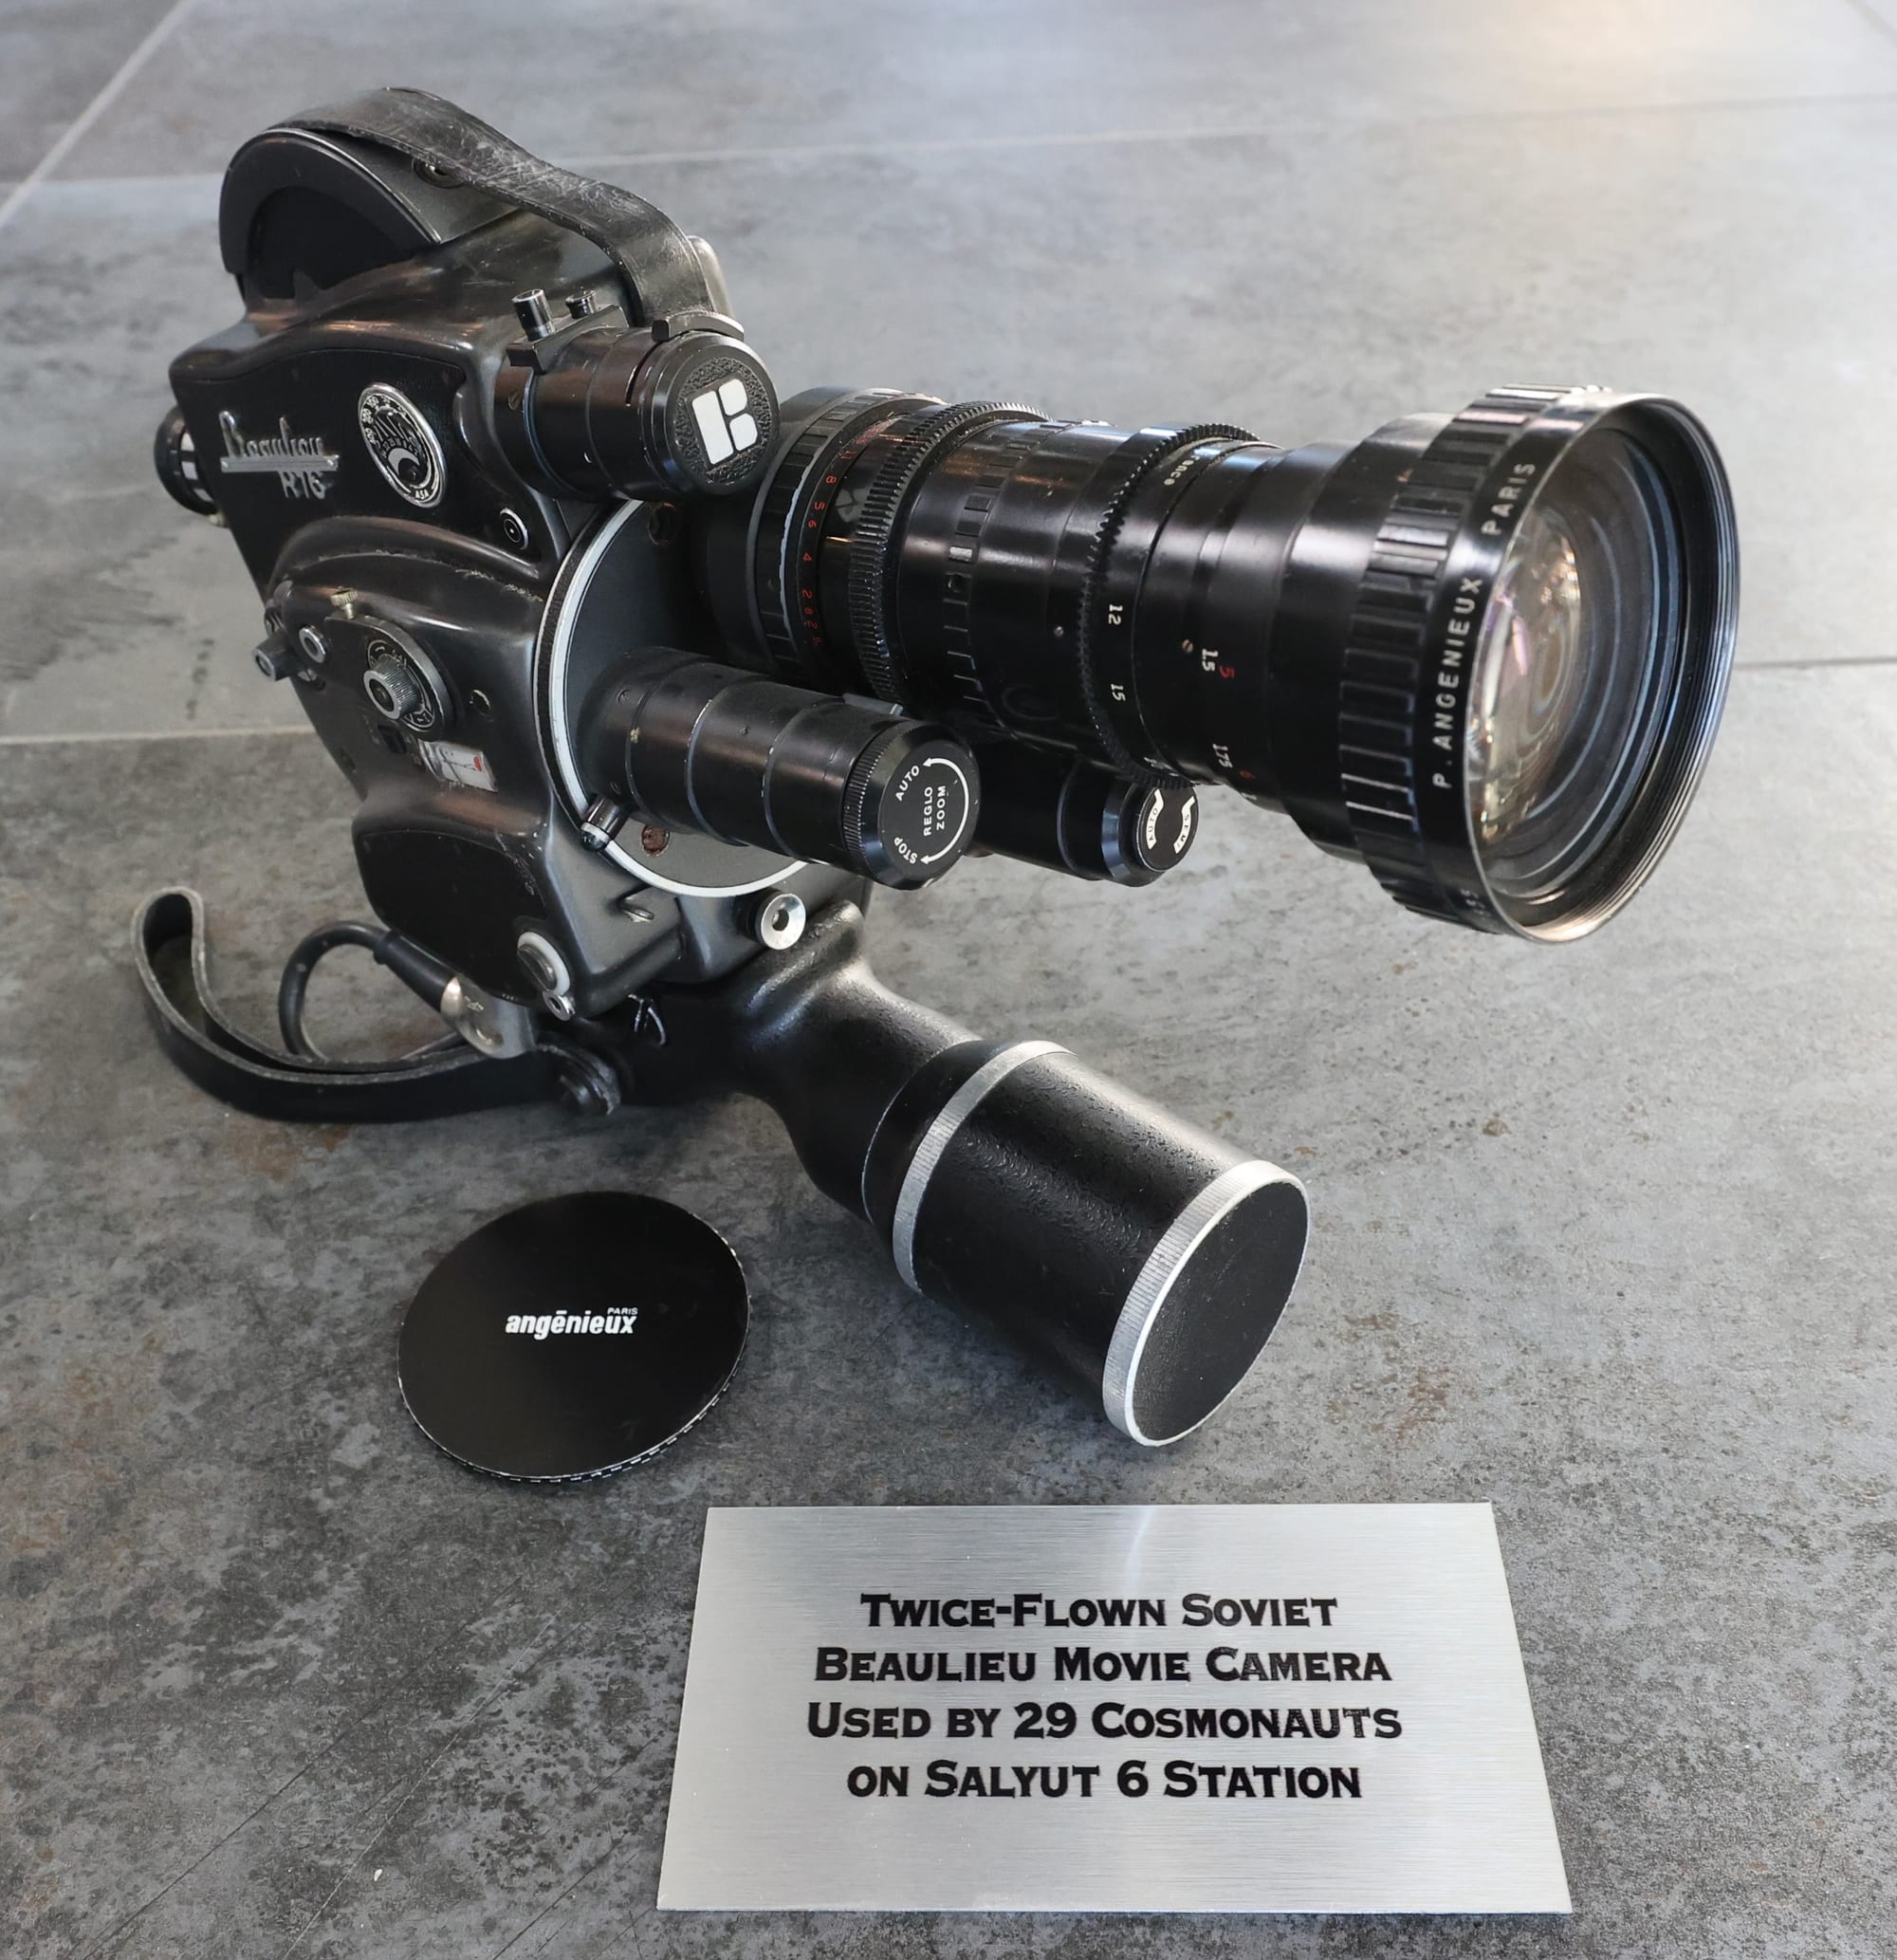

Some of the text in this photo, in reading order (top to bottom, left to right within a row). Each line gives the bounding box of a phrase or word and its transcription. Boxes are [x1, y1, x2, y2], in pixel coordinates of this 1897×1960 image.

[1164, 453, 1203, 486] rance
[414, 489, 430, 499] ASA
[1108, 603, 1123, 625] 12
[1433, 576, 1483, 750] ANGENIEUX
[1481, 462, 1537, 535] PARIS
[1111, 683, 1126, 701] 15
[894, 765, 920, 802] AUTO
[923, 786, 933, 837] REGLO
[935, 785, 947, 831] ZOOM
[1147, 807, 1158, 841] AUTO
[893, 837, 918, 864] STOP
[860, 1593, 1337, 1628] TWICE-FLOWN SOVIET
[815, 1646, 1392, 1682] BEAULIEU MOVIE CAMERA
[807, 1702, 1403, 1739] USED BY 29 COSMONAUTS
[847, 1760, 1362, 1799] ON SALYUT 6 STATION
